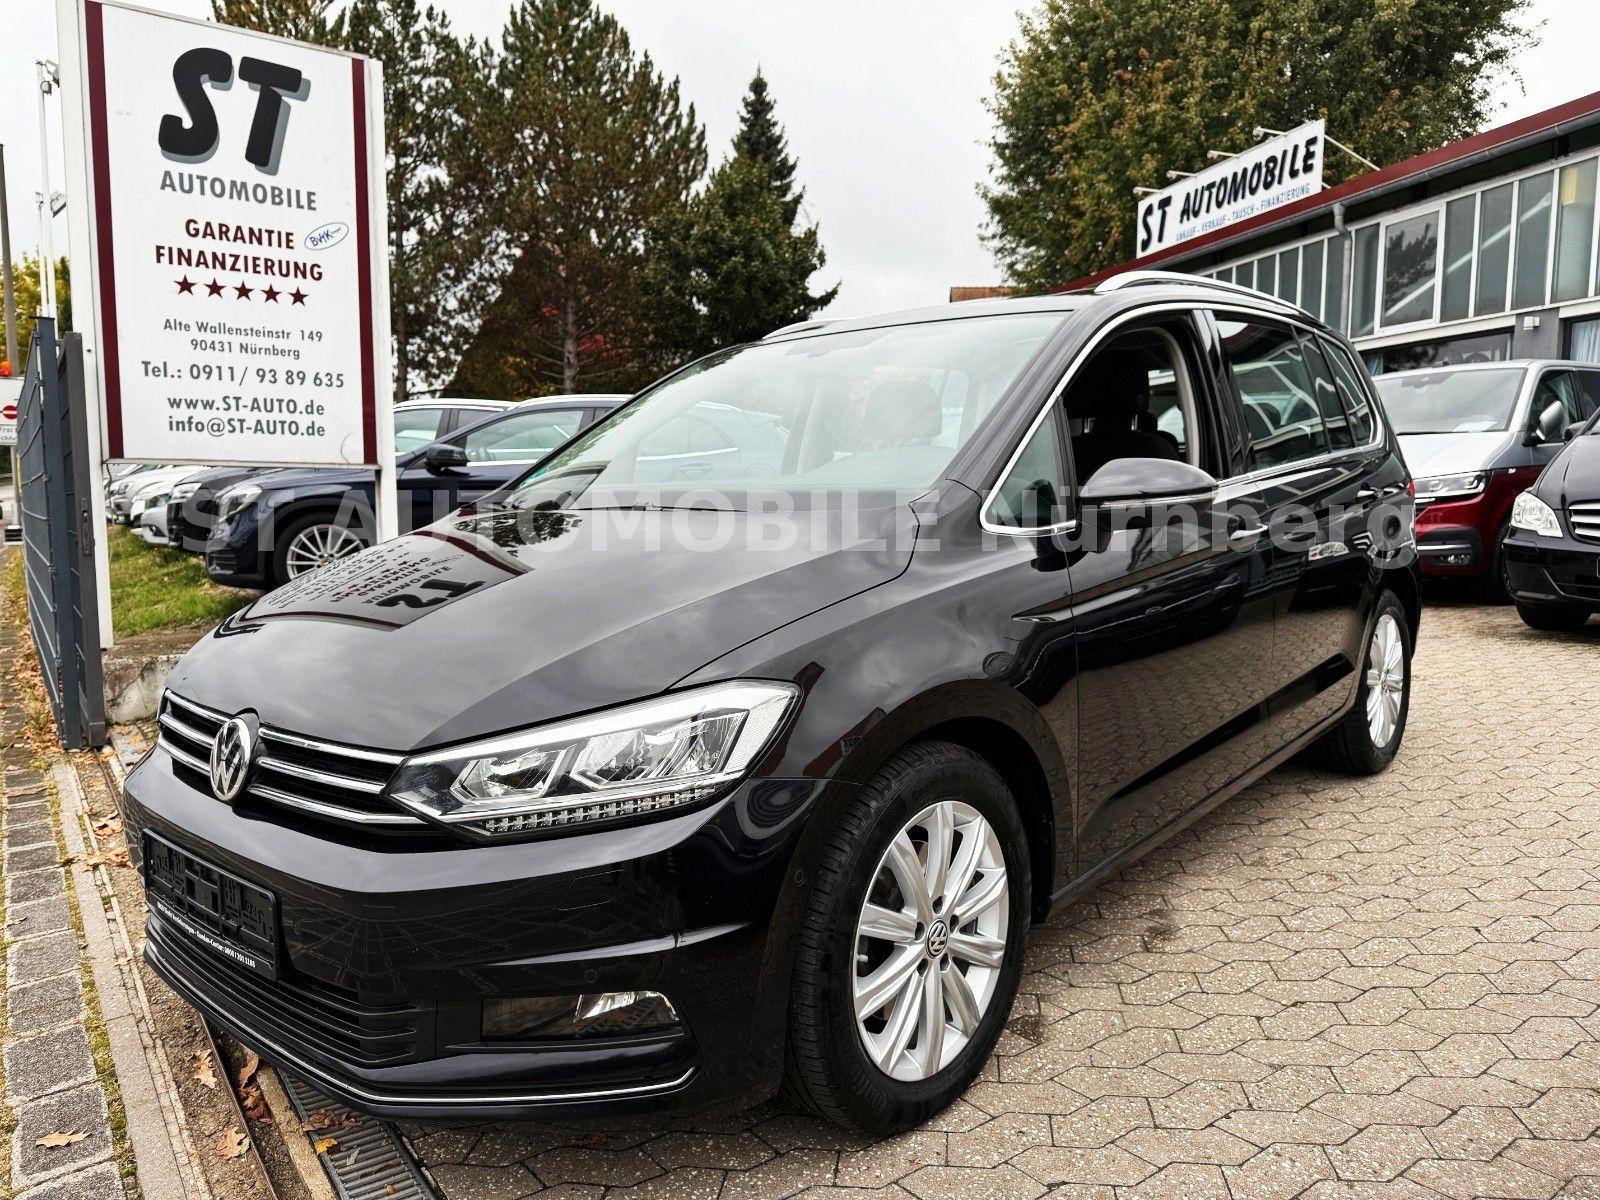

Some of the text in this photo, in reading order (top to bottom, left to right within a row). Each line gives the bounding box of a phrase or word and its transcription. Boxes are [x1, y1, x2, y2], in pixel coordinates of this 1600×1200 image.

[158, 47, 311, 176] ST
[160, 171, 317, 211] AUTOMOBILE
[1141, 136, 1318, 252] ST AUTOMOBILE
[185, 219, 295, 250] GARANTIE
[155, 245, 323, 281] FINANZIERUNG
[163, 318, 323, 342] Alte Wallensteinstr 149
[190, 339, 300, 360] 90431 Nürnberg
[141, 360, 182, 379] Tel.:
[256, 367, 278, 385] 93
[285, 369, 306, 386] 89
[313, 371, 344, 388] 635
[167, 395, 325, 420] www.ST-AUTO.de
[168, 415, 326, 437] info@ST-AUTO.de
